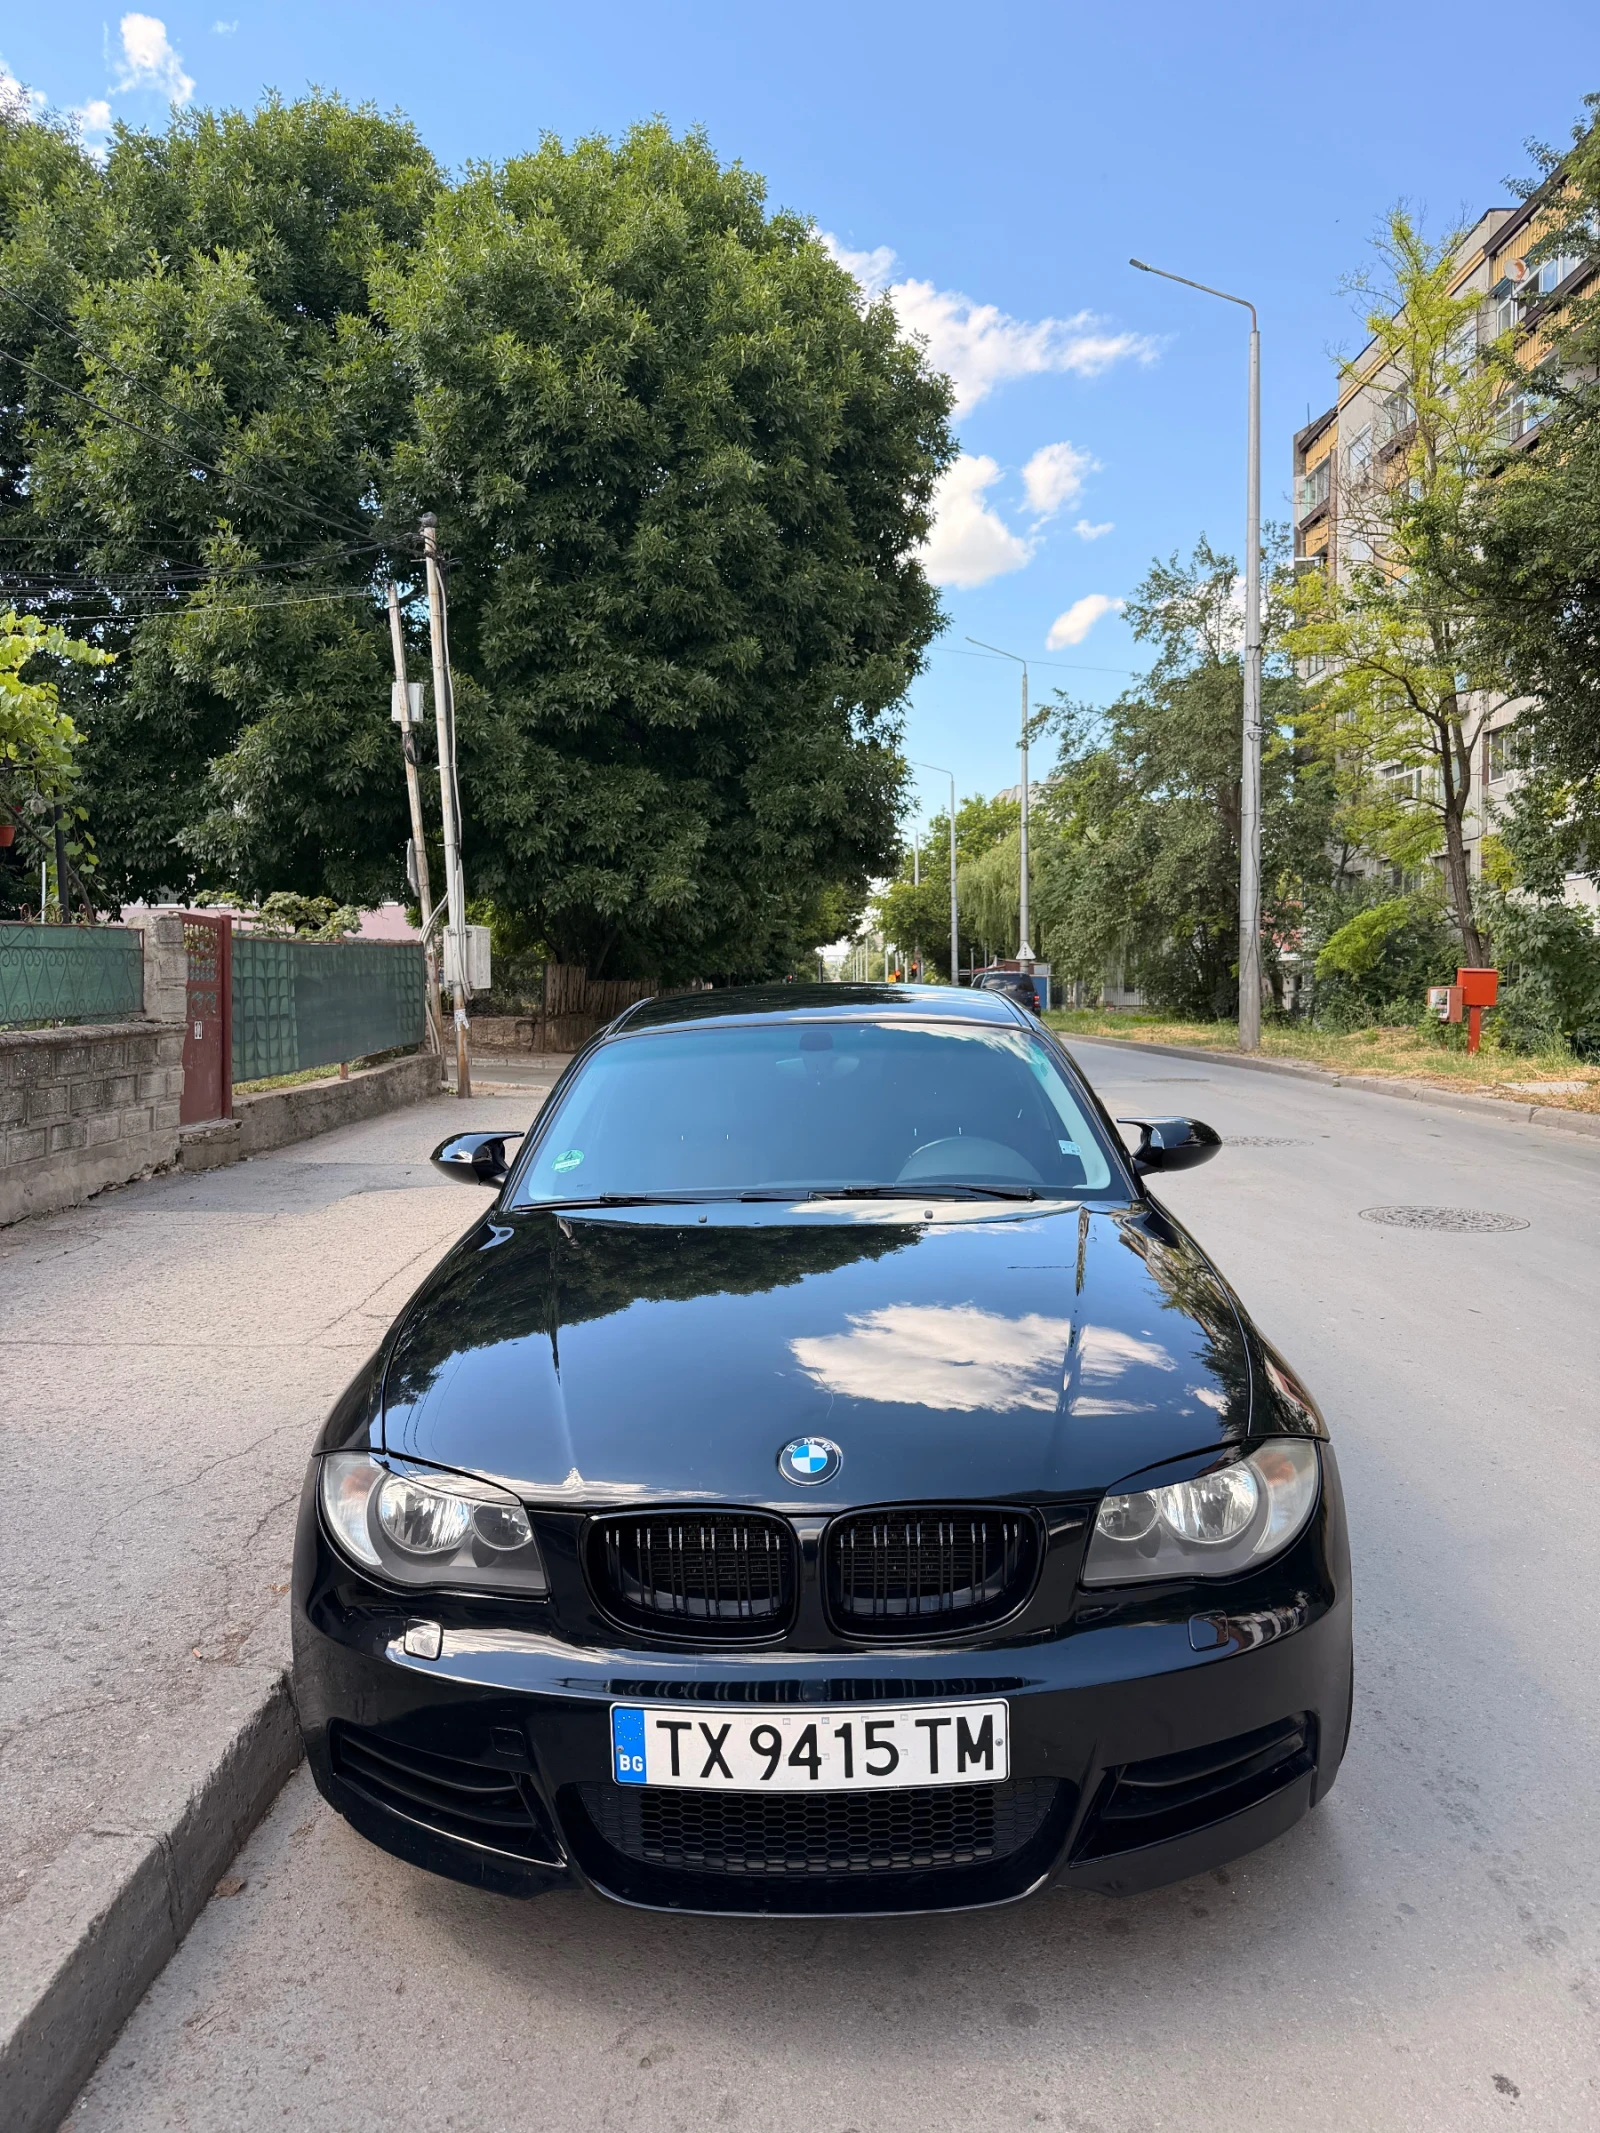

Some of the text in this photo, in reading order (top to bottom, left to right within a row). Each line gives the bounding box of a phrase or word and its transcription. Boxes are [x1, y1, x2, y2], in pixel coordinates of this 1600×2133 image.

[564, 1151, 574, 1160] 4
[787, 1438, 833, 1452] BMW
[655, 1714, 995, 1781] TX 9415 TM
[619, 1754, 644, 1772] BG
